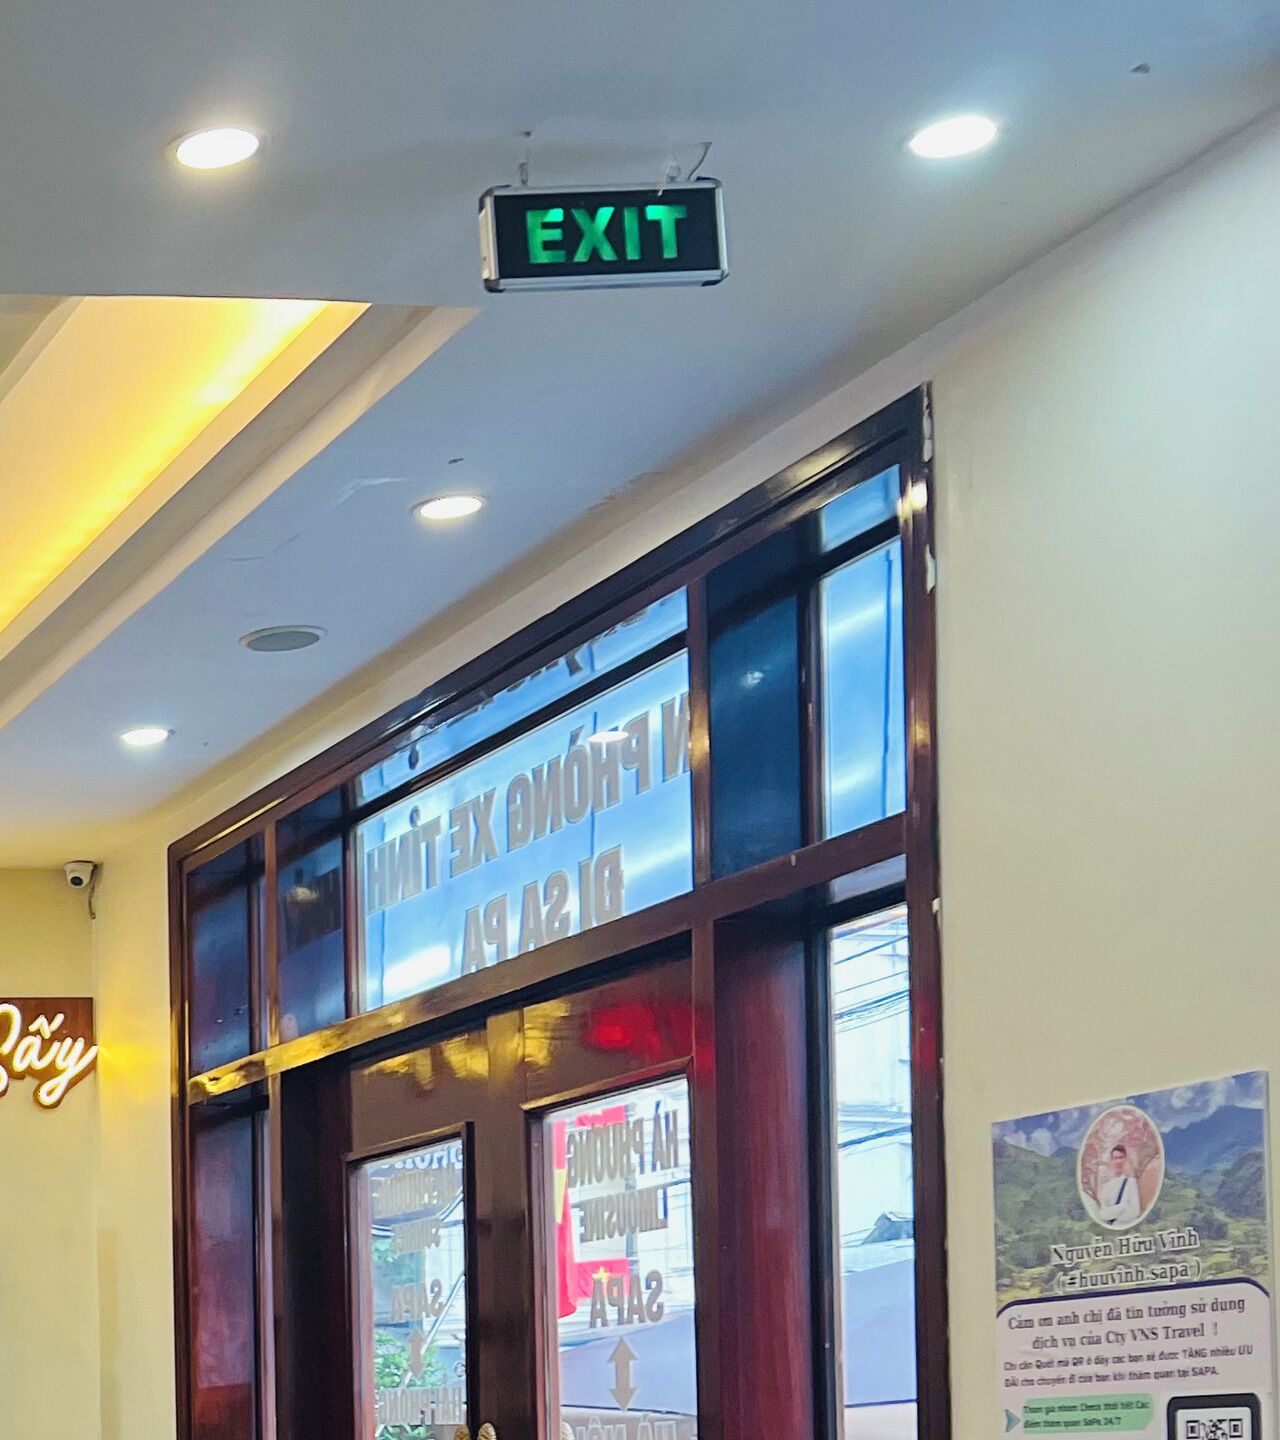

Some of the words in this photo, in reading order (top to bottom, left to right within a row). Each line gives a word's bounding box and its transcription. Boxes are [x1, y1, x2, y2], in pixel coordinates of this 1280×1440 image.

[526, 205, 687, 264] EXIT
[1130, 1327, 1159, 1341] VNS
[1162, 1322, 1205, 1340] Travel
